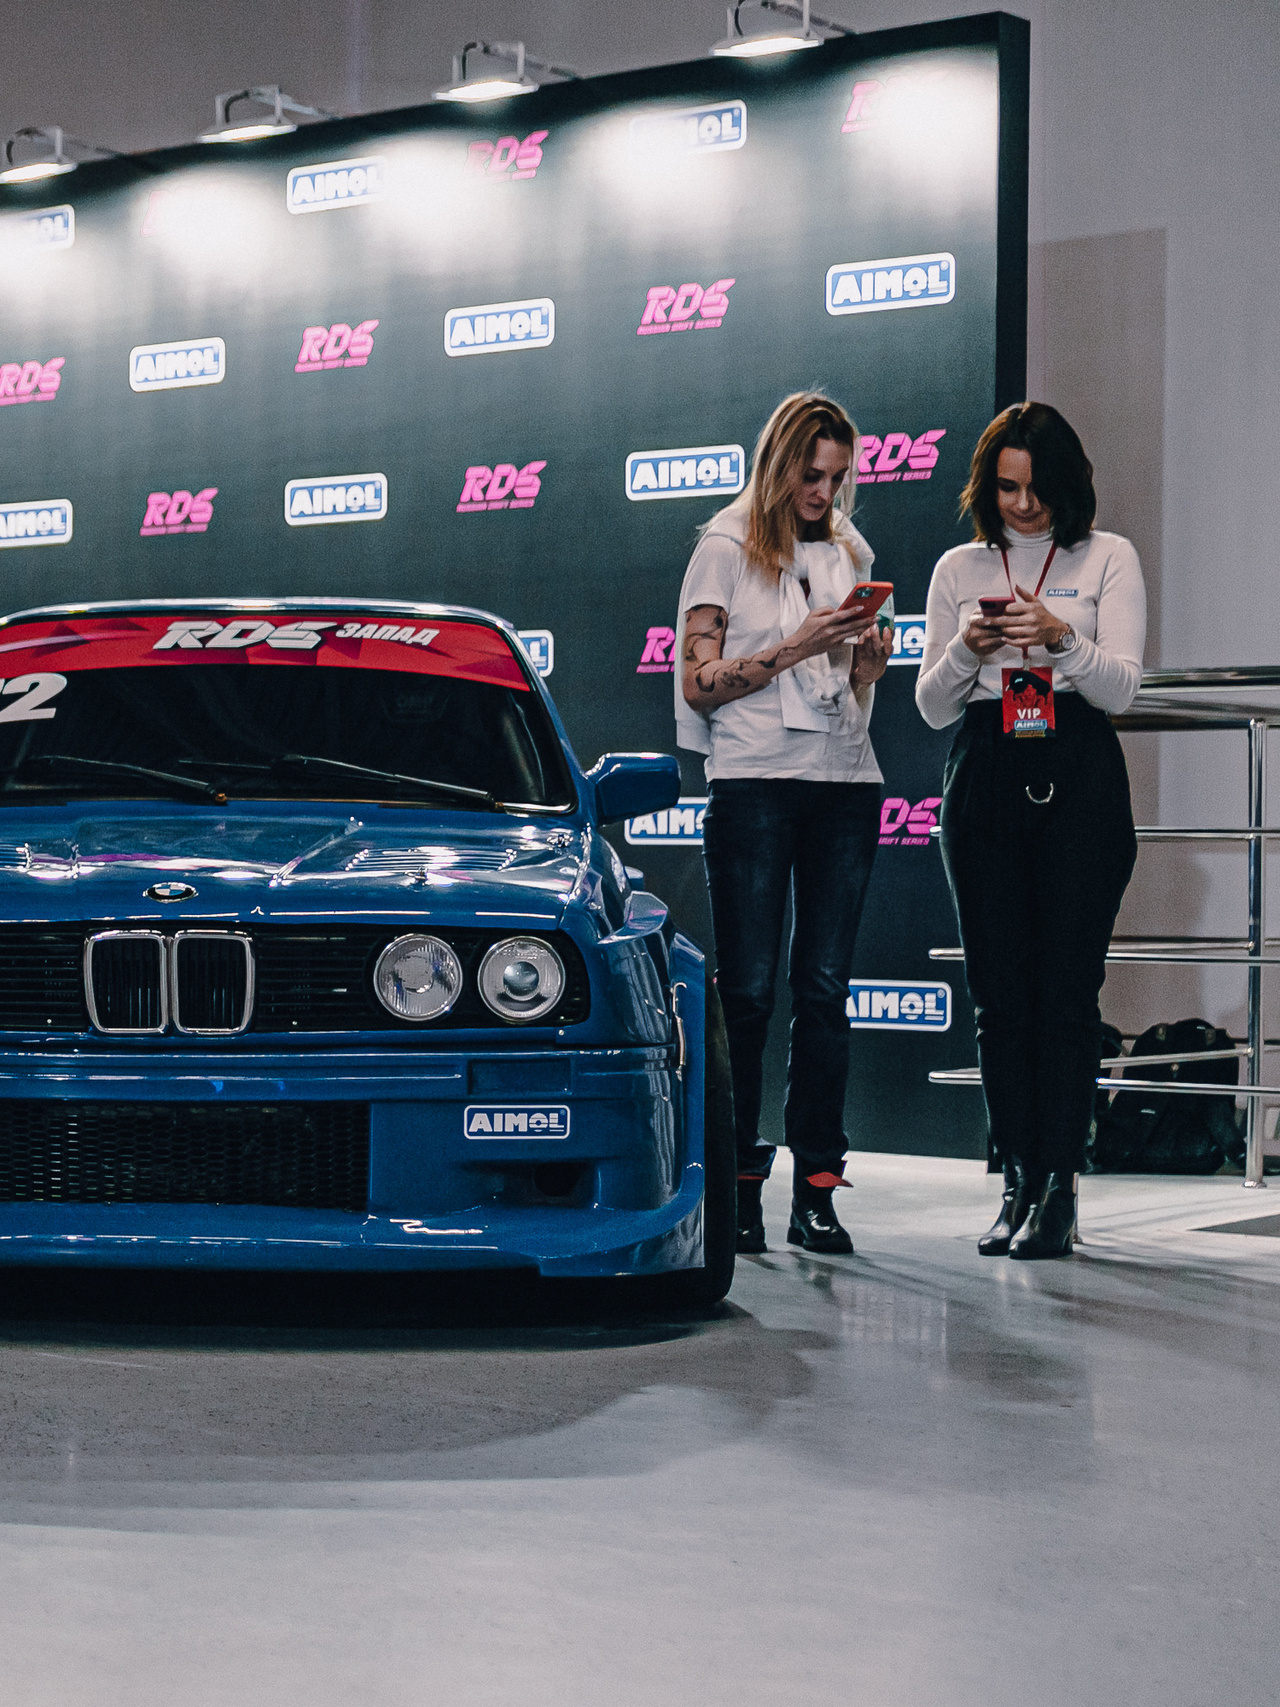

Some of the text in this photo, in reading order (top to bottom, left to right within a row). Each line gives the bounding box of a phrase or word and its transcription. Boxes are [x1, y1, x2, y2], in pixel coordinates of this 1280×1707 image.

[466, 130, 549, 176] RDS
[292, 165, 381, 206] AIMOL
[641, 278, 736, 325] RDS
[832, 264, 948, 305] AIMOL
[298, 319, 379, 363] RDS
[450, 309, 548, 348] AIMOL
[135, 346, 220, 385] AIMOL
[857, 428, 947, 473] RDS
[459, 460, 547, 503] RDS
[632, 456, 740, 491] AIMOL
[144, 488, 218, 527] RDS
[290, 483, 381, 517] AIMOL
[153, 620, 440, 650] RDS ЗАПАД
[1016, 707, 1041, 720] VIP
[630, 807, 704, 835] AIM
[879, 797, 943, 835] DS
[468, 1112, 565, 1133] AIMOL
